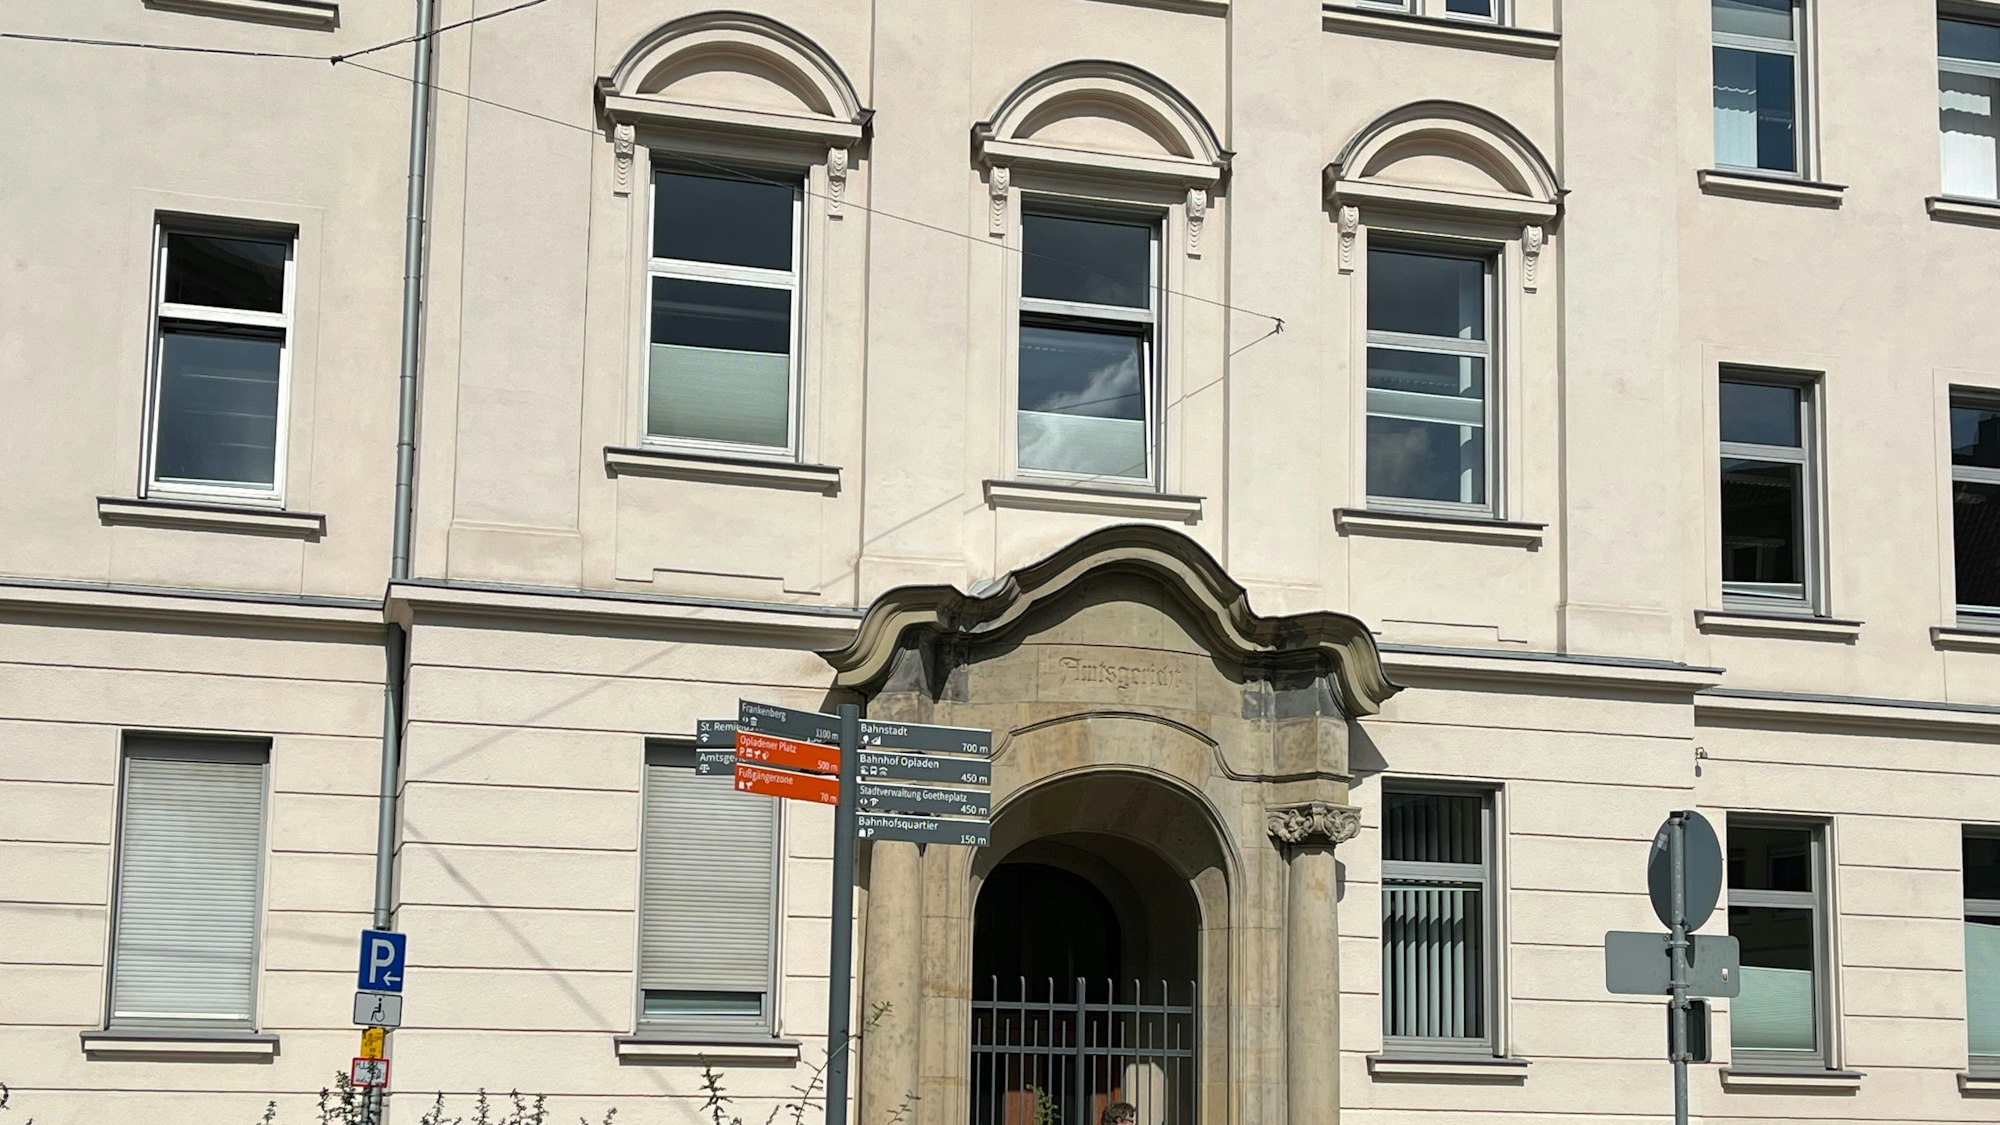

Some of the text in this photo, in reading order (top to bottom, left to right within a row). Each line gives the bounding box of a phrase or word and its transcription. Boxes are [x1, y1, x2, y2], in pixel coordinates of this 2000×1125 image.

[1058, 656, 1182, 690] Amtsgericht
[741, 702, 786, 722] Frankenberg
[700, 722, 711, 731] St.
[860, 723, 908, 736] Bahnstadt
[815, 728, 831, 740] 1100
[831, 732, 839, 740] m
[740, 735, 797, 754] Opladener Platz
[962, 743, 977, 753] 700
[817, 760, 830, 771] 500
[830, 764, 838, 772] m
[860, 754, 939, 769] Bahnhof Opladen
[738, 768, 794, 785] Fußgängerzone
[961, 773, 987, 784] 450 m
[820, 792, 837, 804] 70 m
[860, 785, 967, 803] Stadtverwaltung Goetheplatz
[961, 804, 987, 815] 450 m
[858, 816, 939, 831] Bahnhofsquartier
[960, 835, 987, 845] 150 m
[369, 938, 396, 984] P
